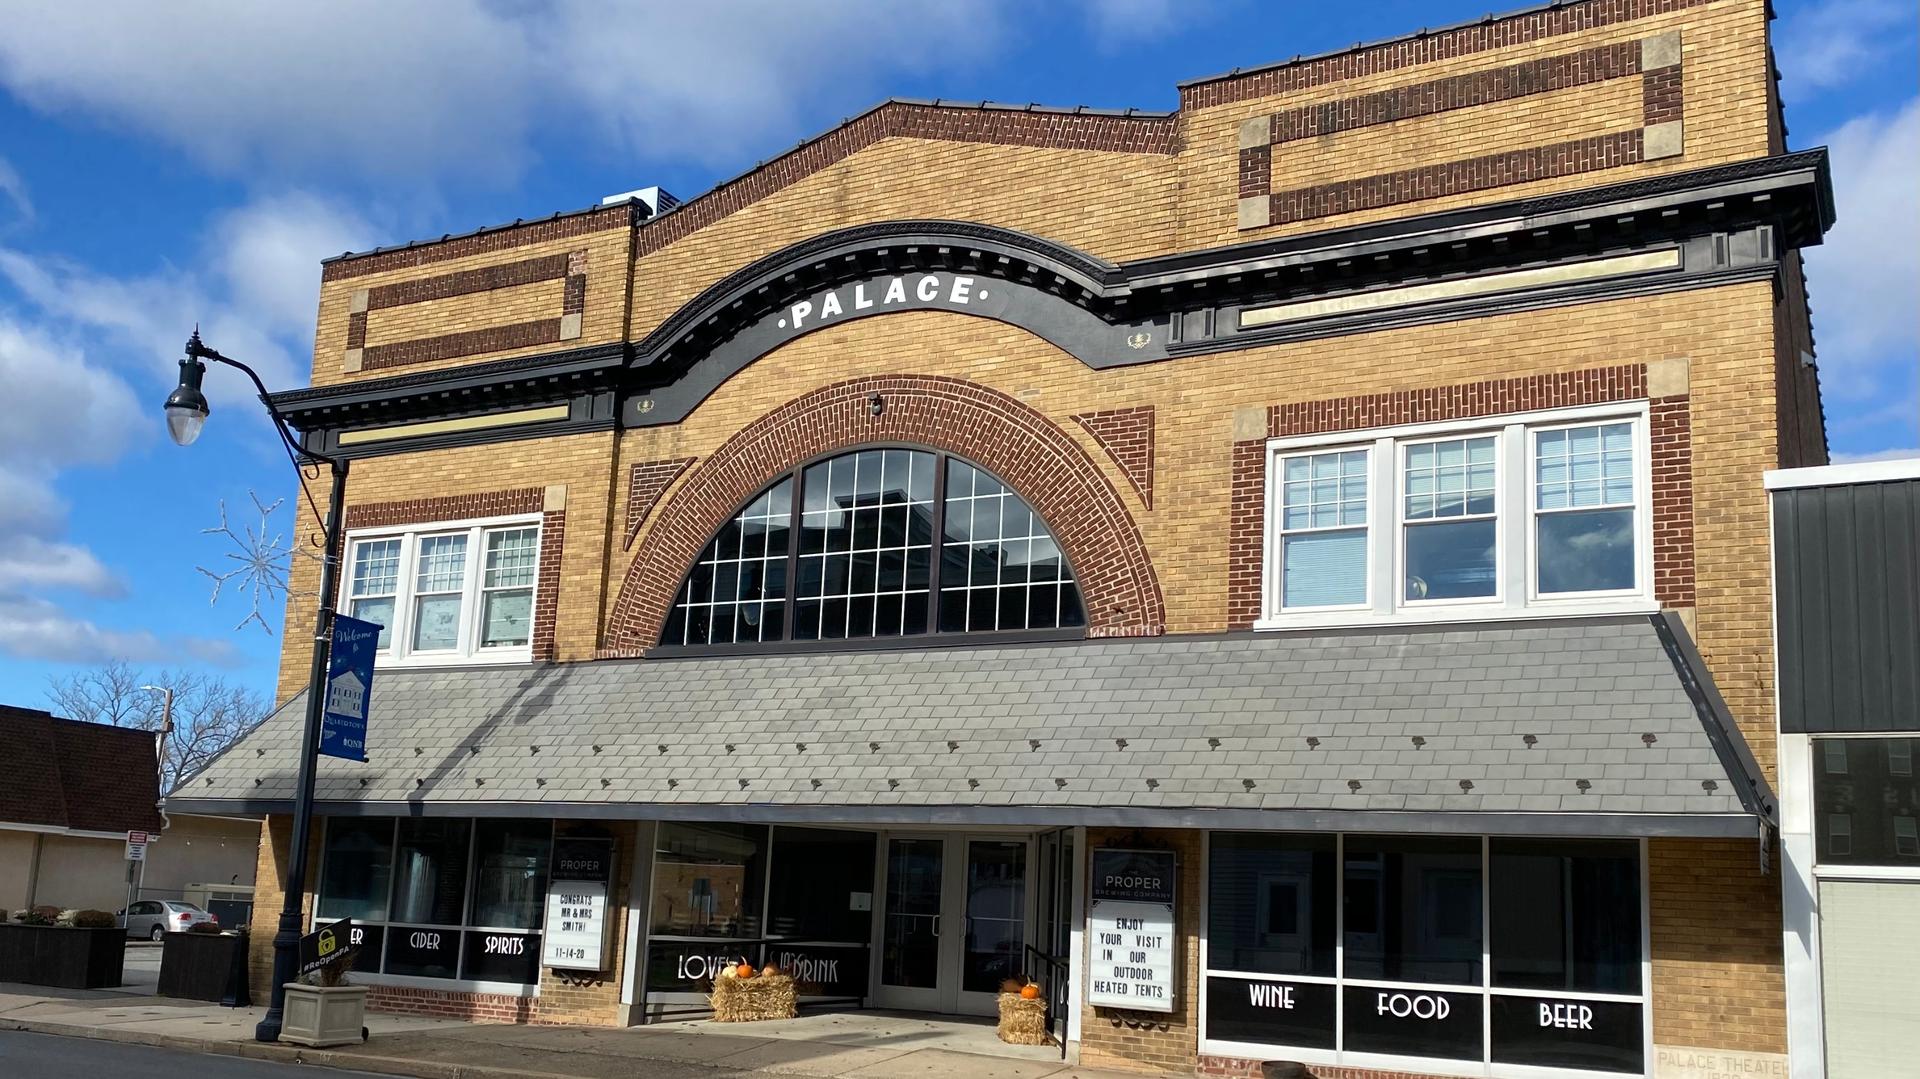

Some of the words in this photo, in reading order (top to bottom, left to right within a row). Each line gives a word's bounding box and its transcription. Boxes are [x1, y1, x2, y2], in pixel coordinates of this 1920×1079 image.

[791, 276, 974, 328] PALACE
[560, 859, 599, 870] PROPER
[1105, 875, 1161, 889] PROPER
[560, 894, 592, 905] CONGRATS
[561, 907, 571, 918] MR
[572, 908, 578, 918] &
[579, 909, 592, 918] MRS
[1116, 917, 1144, 930] ENJOY
[410, 931, 441, 950] CIDER
[485, 936, 524, 955] SPIRITS
[1100, 933, 1122, 945] YOUR
[1136, 935, 1162, 948] VISIT
[556, 947, 584, 959] 11-14-20
[1103, 949, 1113, 960] IN
[1129, 951, 1146, 963] OUR
[1113, 966, 1153, 980] OUTDOOR
[1094, 980, 1128, 994] HEATED
[1135, 984, 1163, 998] TENTS
[1249, 983, 1295, 1009] WINE
[1377, 992, 1450, 1020] FOOD
[1539, 1002, 1593, 1030] BEER
[1658, 1051, 1716, 1070] PALACE
